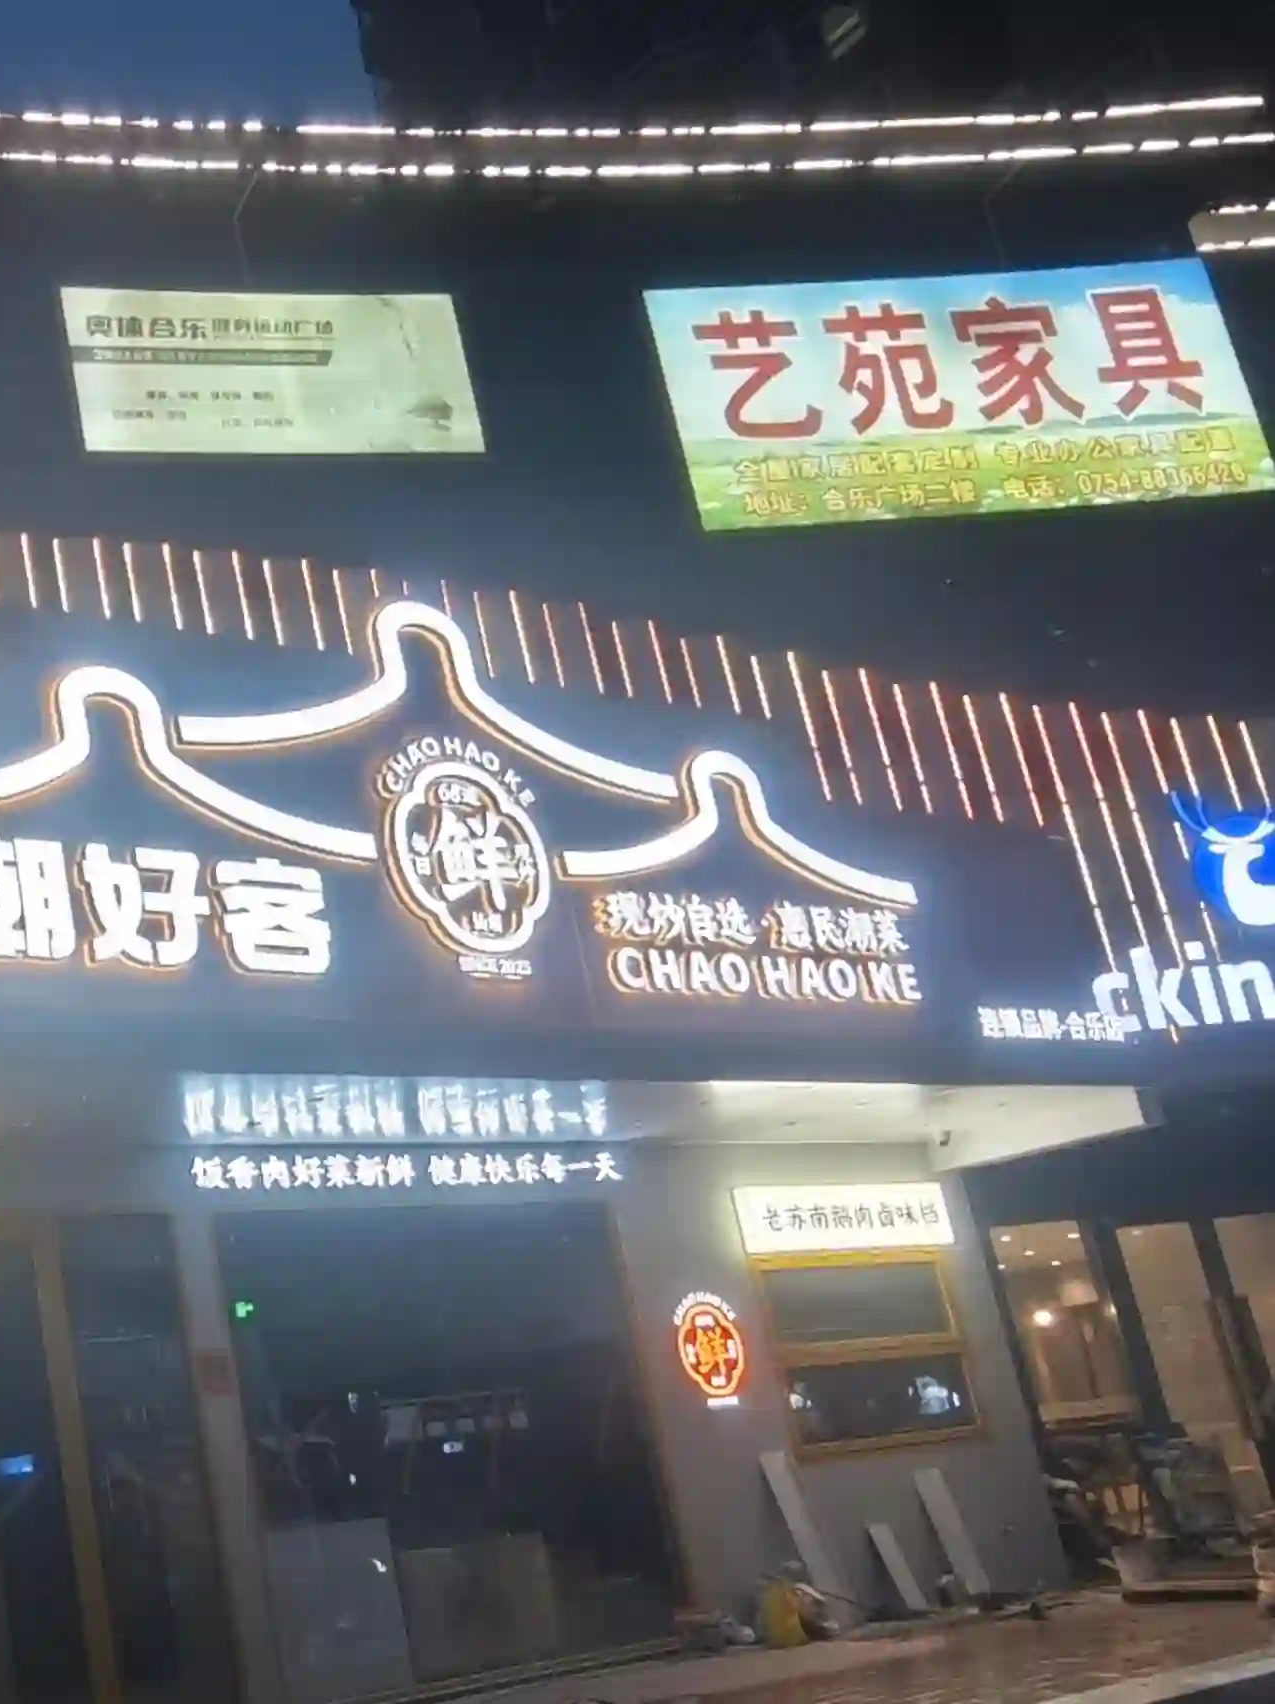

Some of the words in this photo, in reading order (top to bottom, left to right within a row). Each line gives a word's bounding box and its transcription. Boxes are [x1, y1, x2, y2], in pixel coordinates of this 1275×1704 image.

[691, 287, 1204, 439] 艺苑家具
[823, 477, 977, 513] 合乐广场二楼
[616, 945, 751, 994] CHAO
[760, 953, 858, 1000] HAO
[867, 960, 923, 1002] KE
[427, 1151, 623, 1186] 健康快乐每一天
